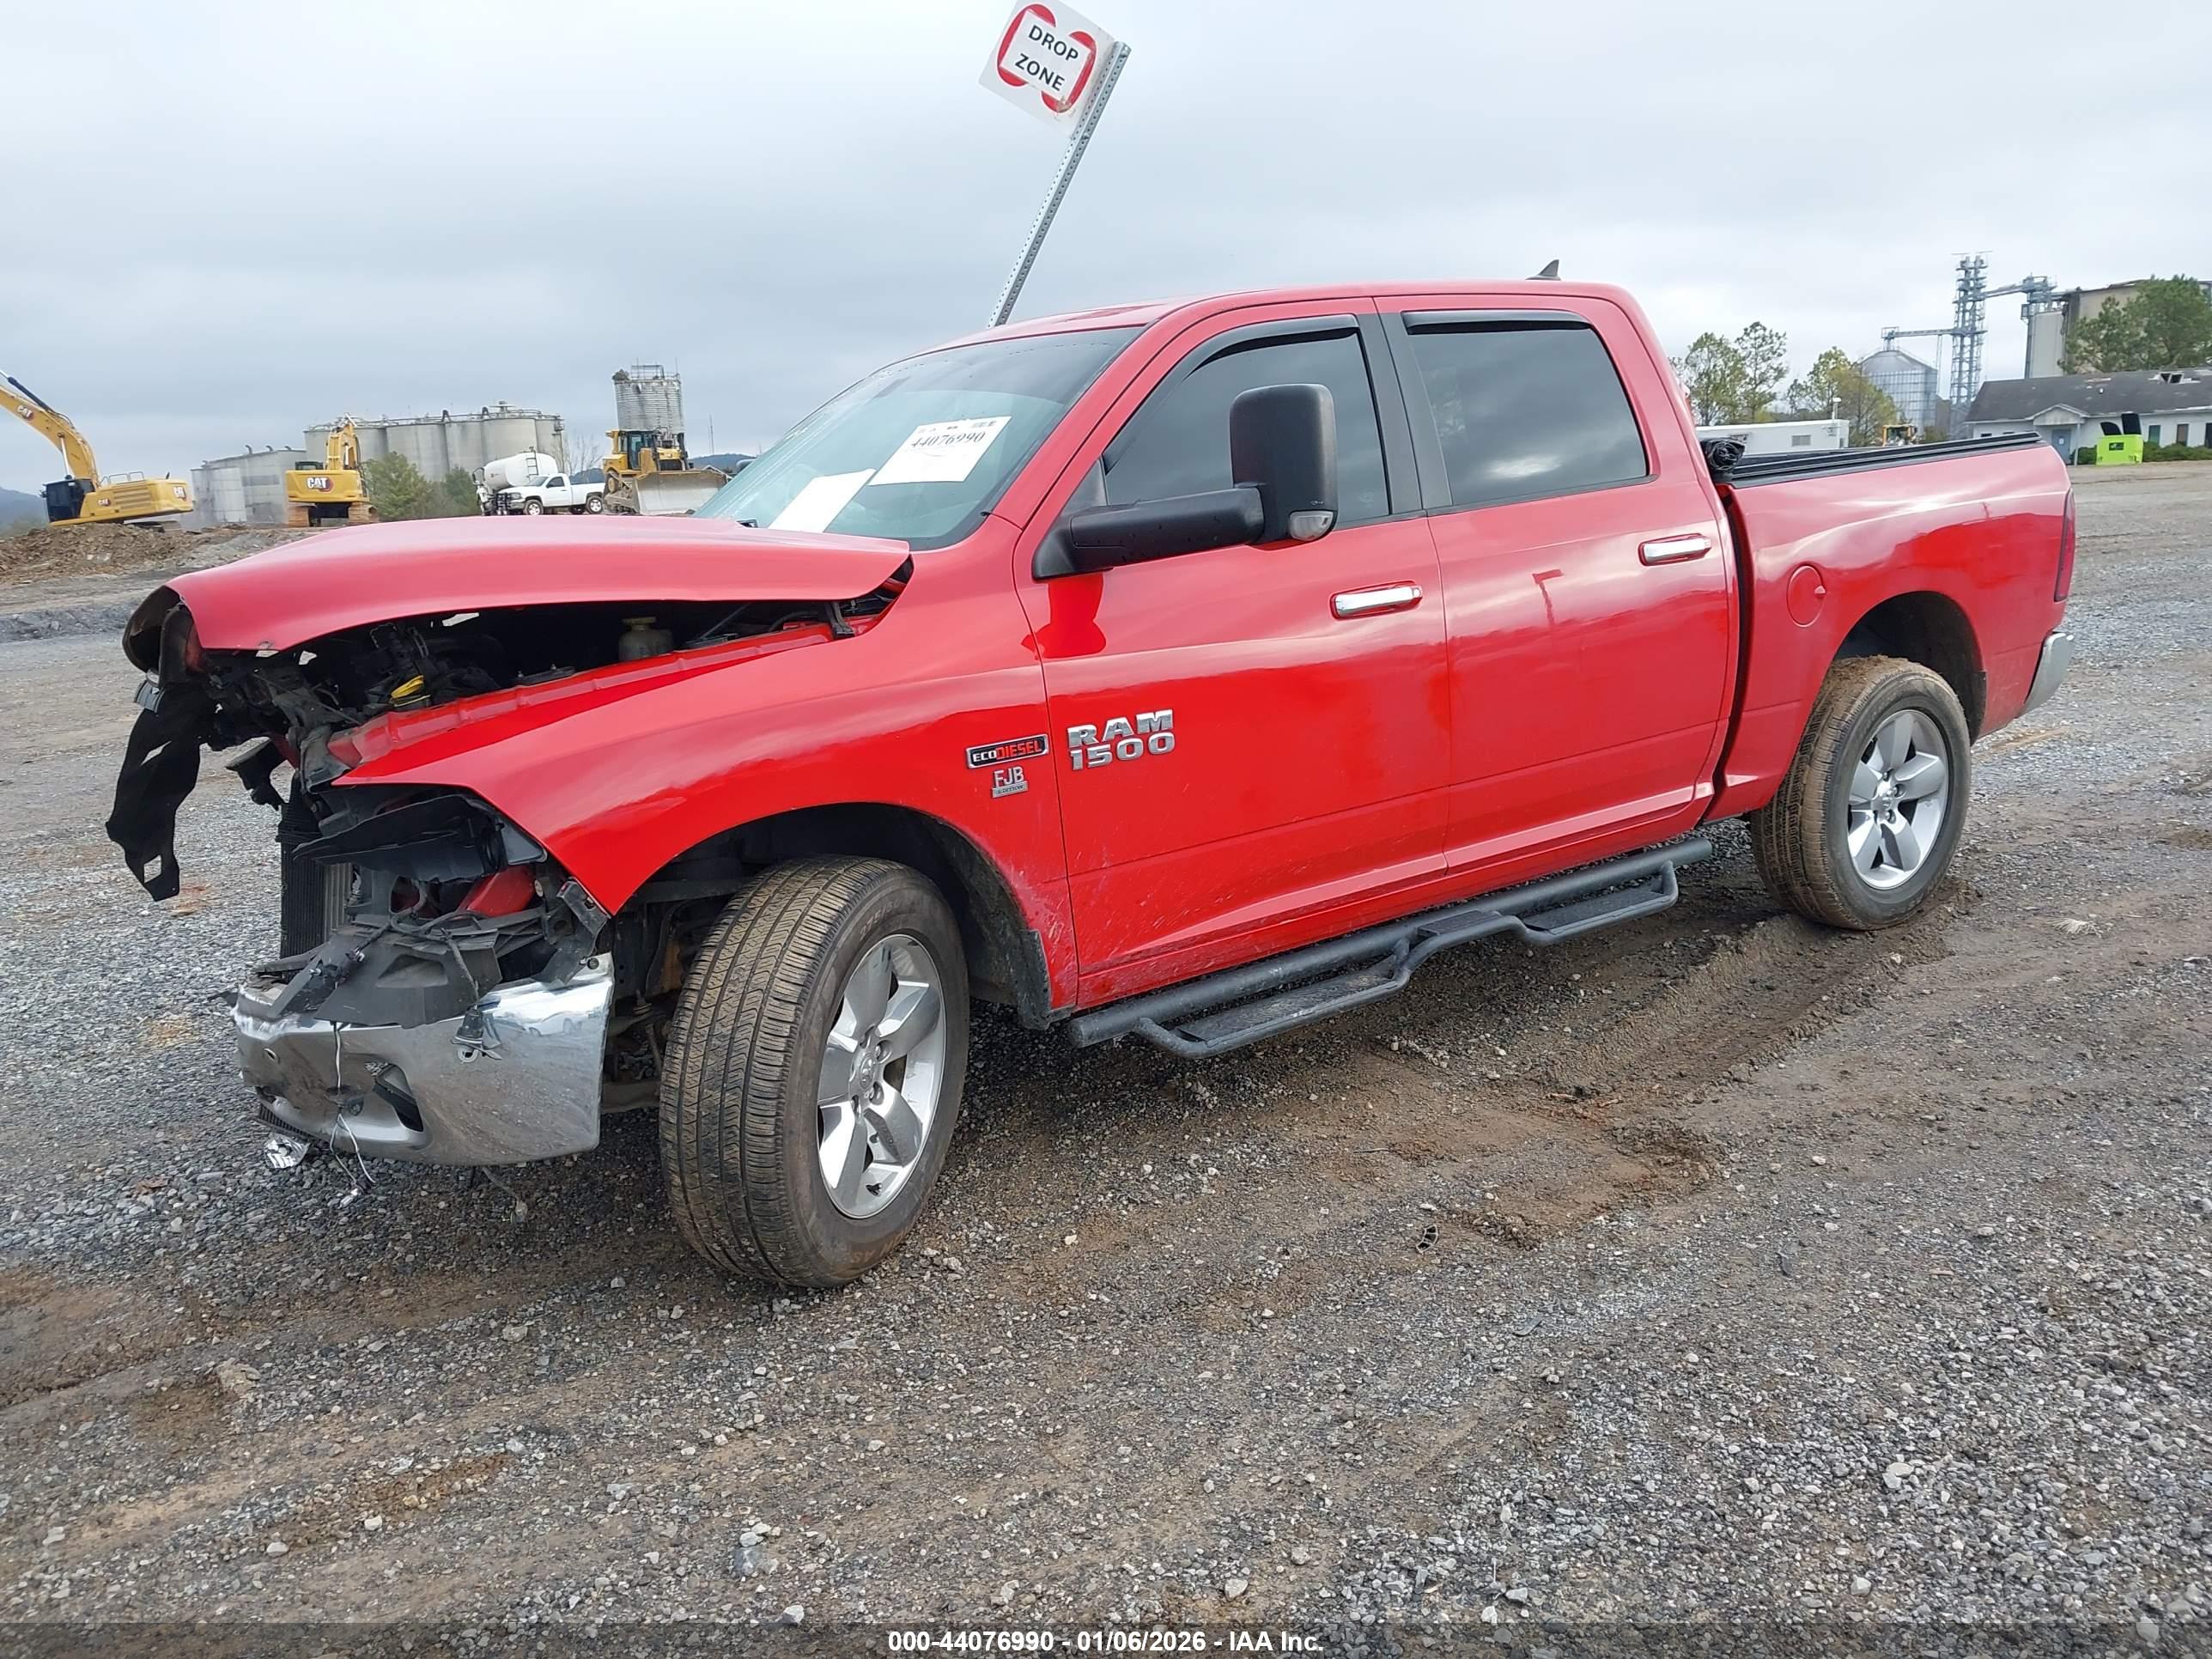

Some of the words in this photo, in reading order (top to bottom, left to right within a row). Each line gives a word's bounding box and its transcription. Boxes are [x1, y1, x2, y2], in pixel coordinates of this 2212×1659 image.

[1028, 24, 1079, 62] DROP
[1015, 53, 1065, 92] ZONE
[911, 431, 987, 448] 44076990
[307, 477, 328, 489] CAT
[1067, 709, 1173, 749] RAM
[972, 738, 1042, 763] ECODIESEL
[1069, 732, 1176, 770] 1500
[994, 765, 1024, 788] FJB
